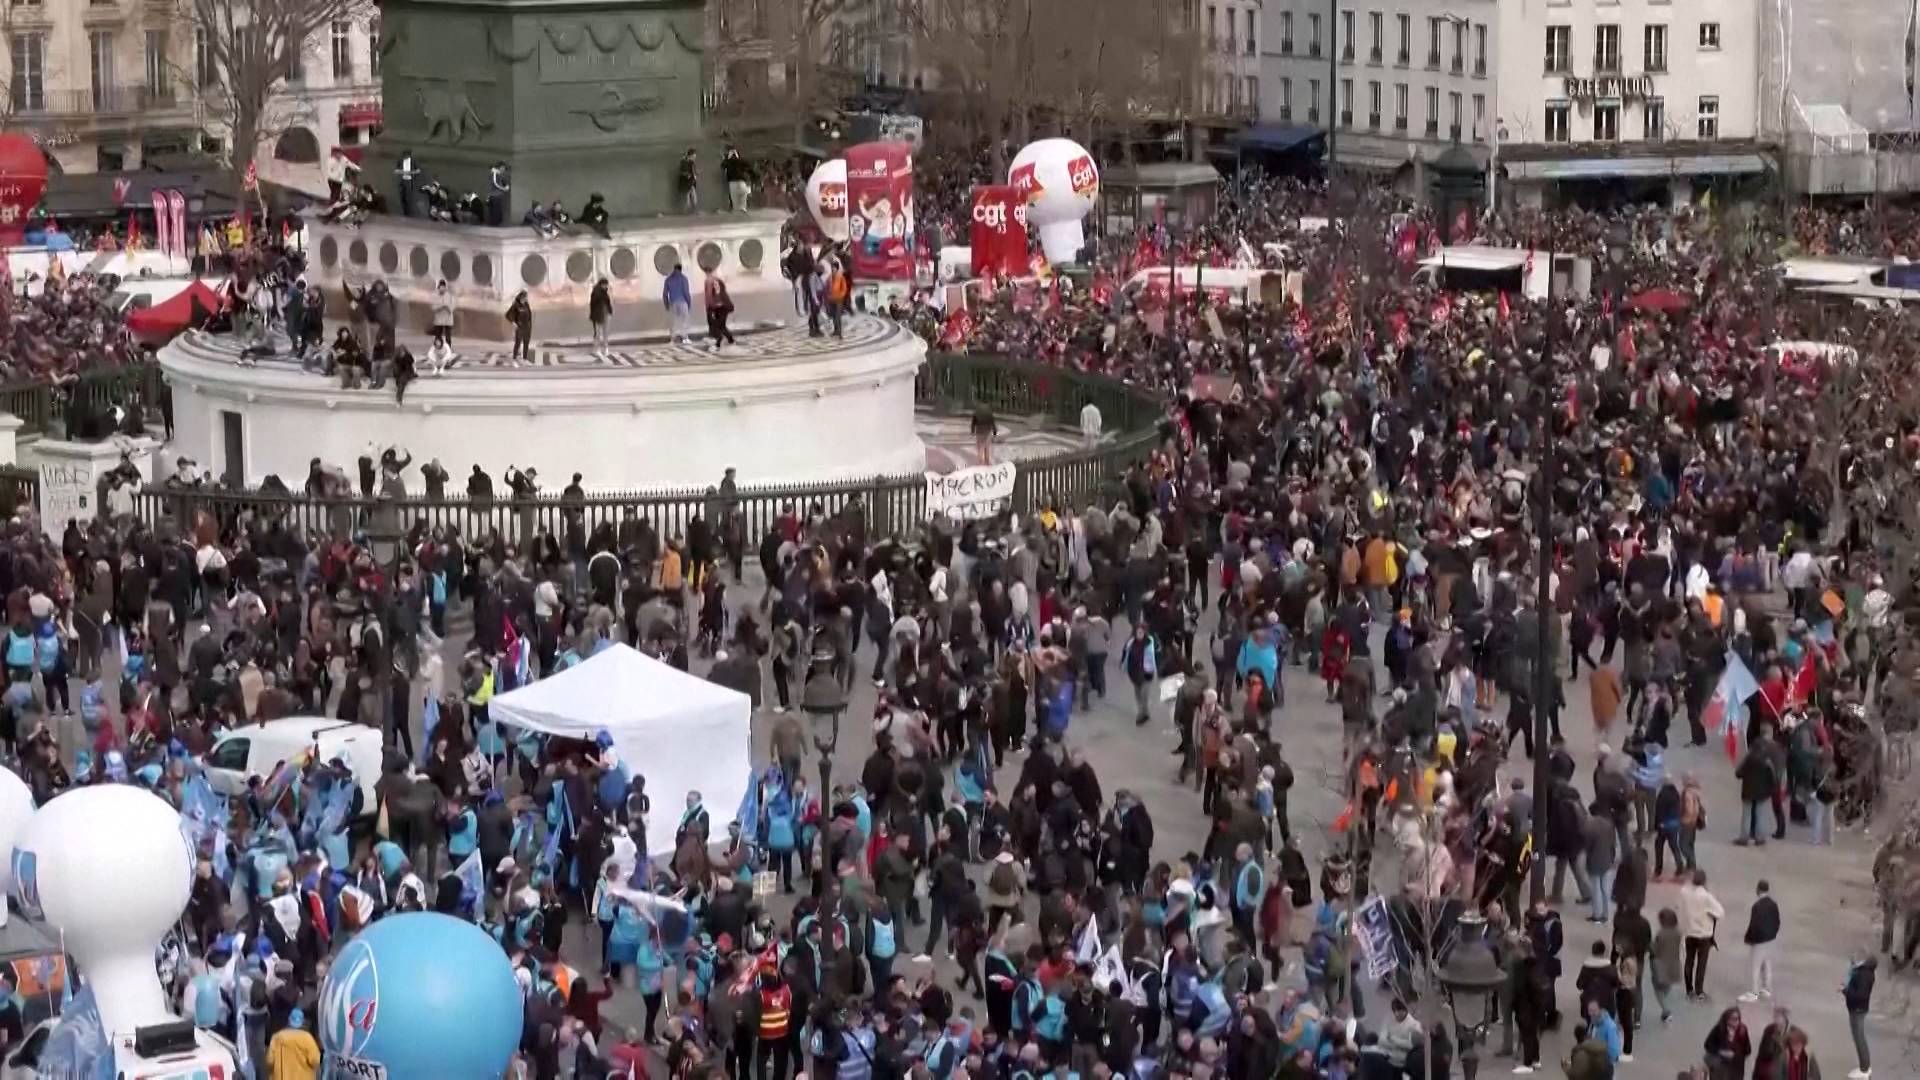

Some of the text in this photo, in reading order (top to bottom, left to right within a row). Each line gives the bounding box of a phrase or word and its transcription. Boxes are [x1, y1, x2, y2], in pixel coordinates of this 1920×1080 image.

[1607, 76, 1652, 97] MILOU
[1072, 164, 1094, 187] cgt
[973, 200, 1007, 228] cgt
[931, 466, 1008, 496] MACRON
